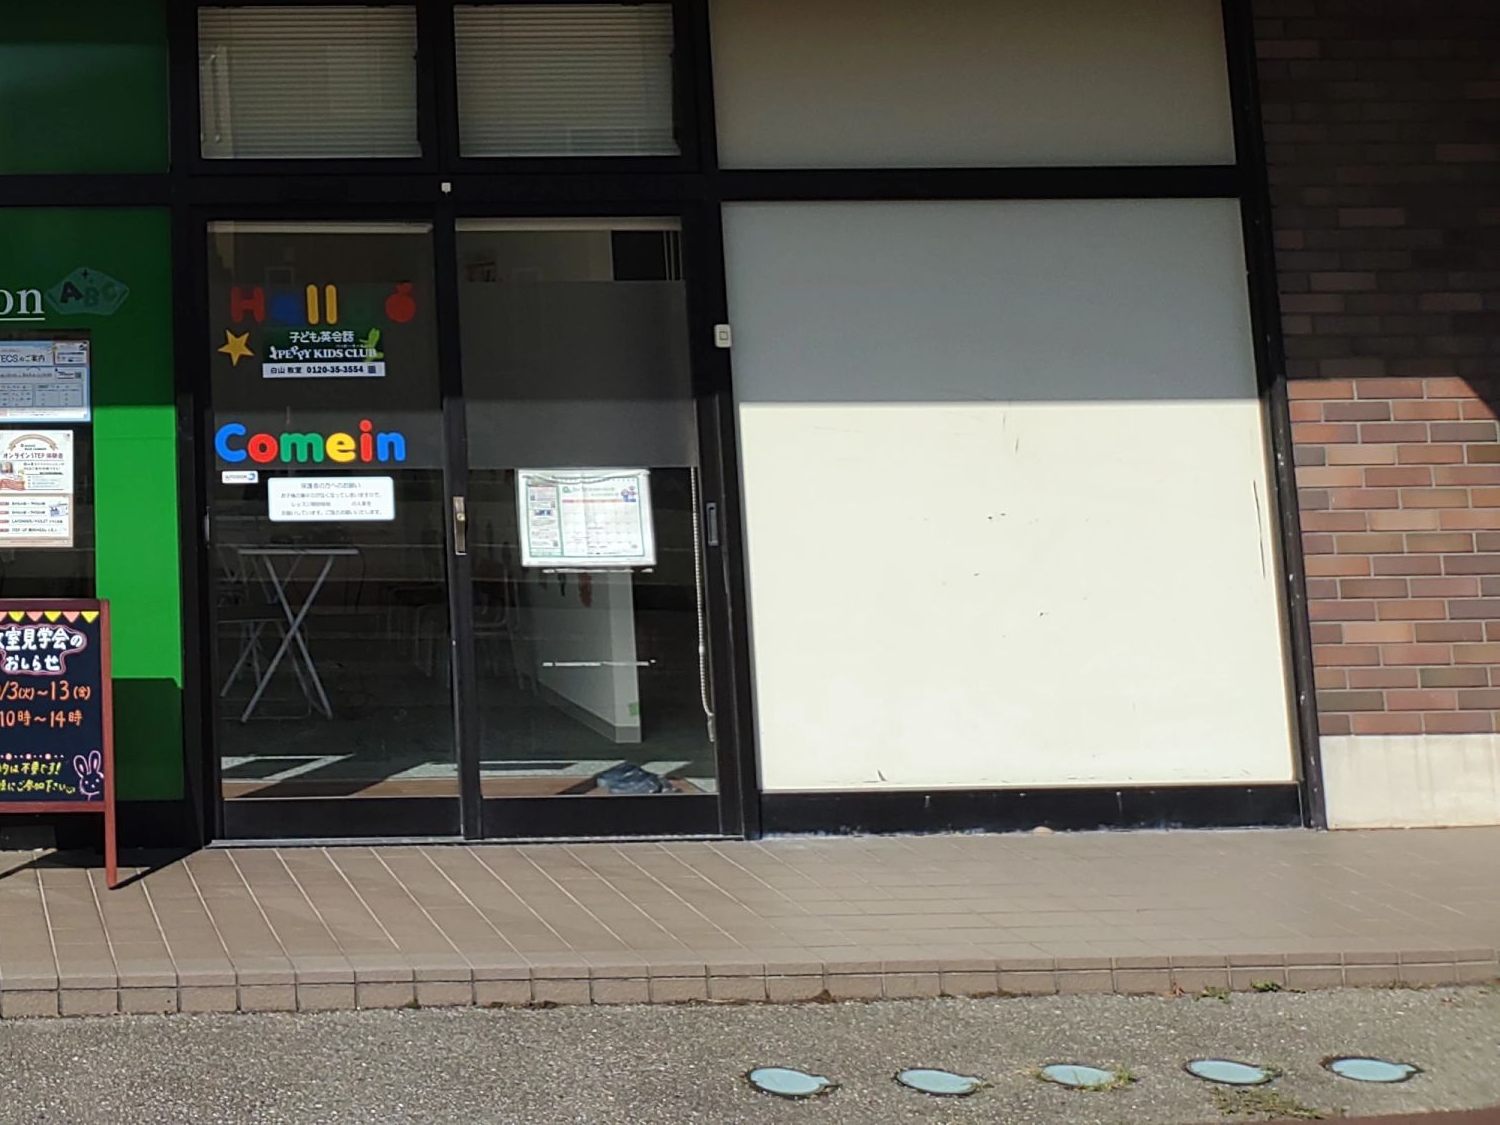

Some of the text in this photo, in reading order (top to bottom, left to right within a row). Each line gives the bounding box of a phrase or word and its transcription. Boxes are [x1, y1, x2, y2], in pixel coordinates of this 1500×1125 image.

[289, 330, 355, 343] 子ども英会話
[314, 349, 343, 359] KIDS
[345, 348, 378, 359] CLUB
[306, 365, 364, 374] 0120-35-3554
[3, 653, 61, 672] おしらせ
